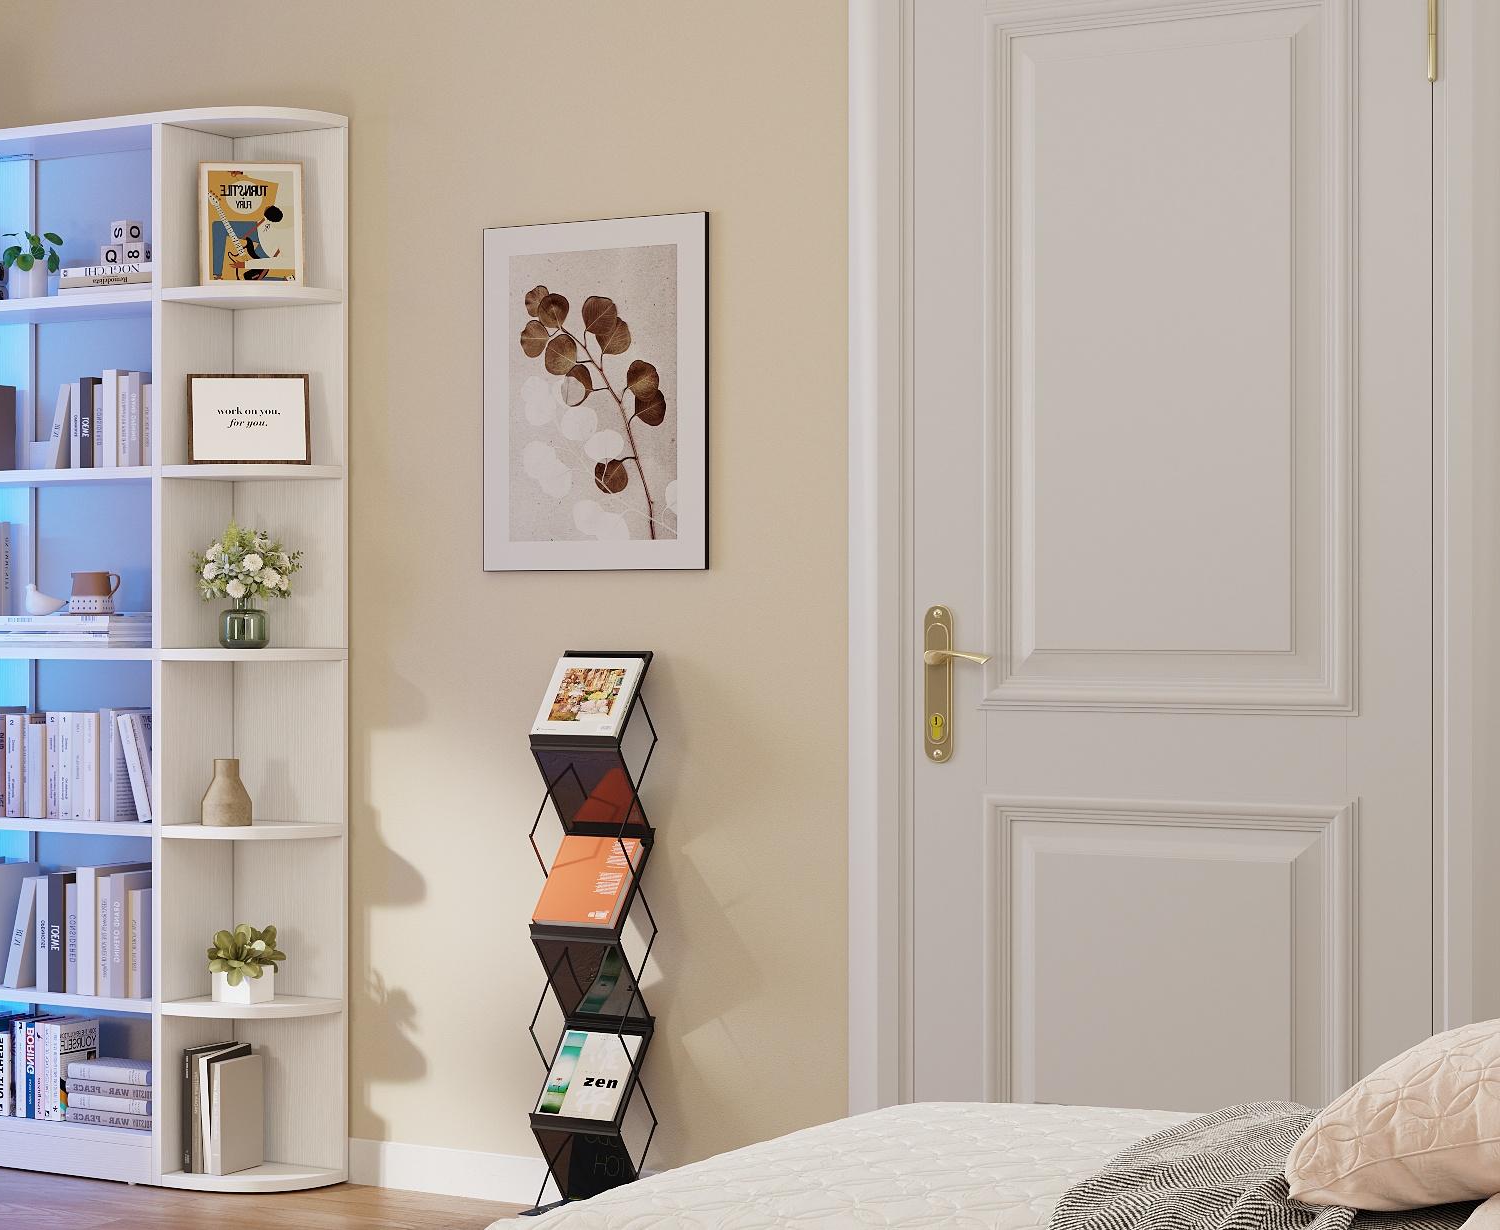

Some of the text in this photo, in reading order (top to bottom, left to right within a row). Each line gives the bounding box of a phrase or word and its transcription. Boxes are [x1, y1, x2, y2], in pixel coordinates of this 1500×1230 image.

[105, 249, 118, 264] Q
[127, 250, 140, 259] 8
[84, 263, 141, 277] NOGUCHI
[92, 276, 128, 285] Remodelista
[217, 406, 243, 416] work
[259, 408, 282, 418] you,
[227, 418, 268, 429] for you.
[583, 1077, 618, 1088] zen
